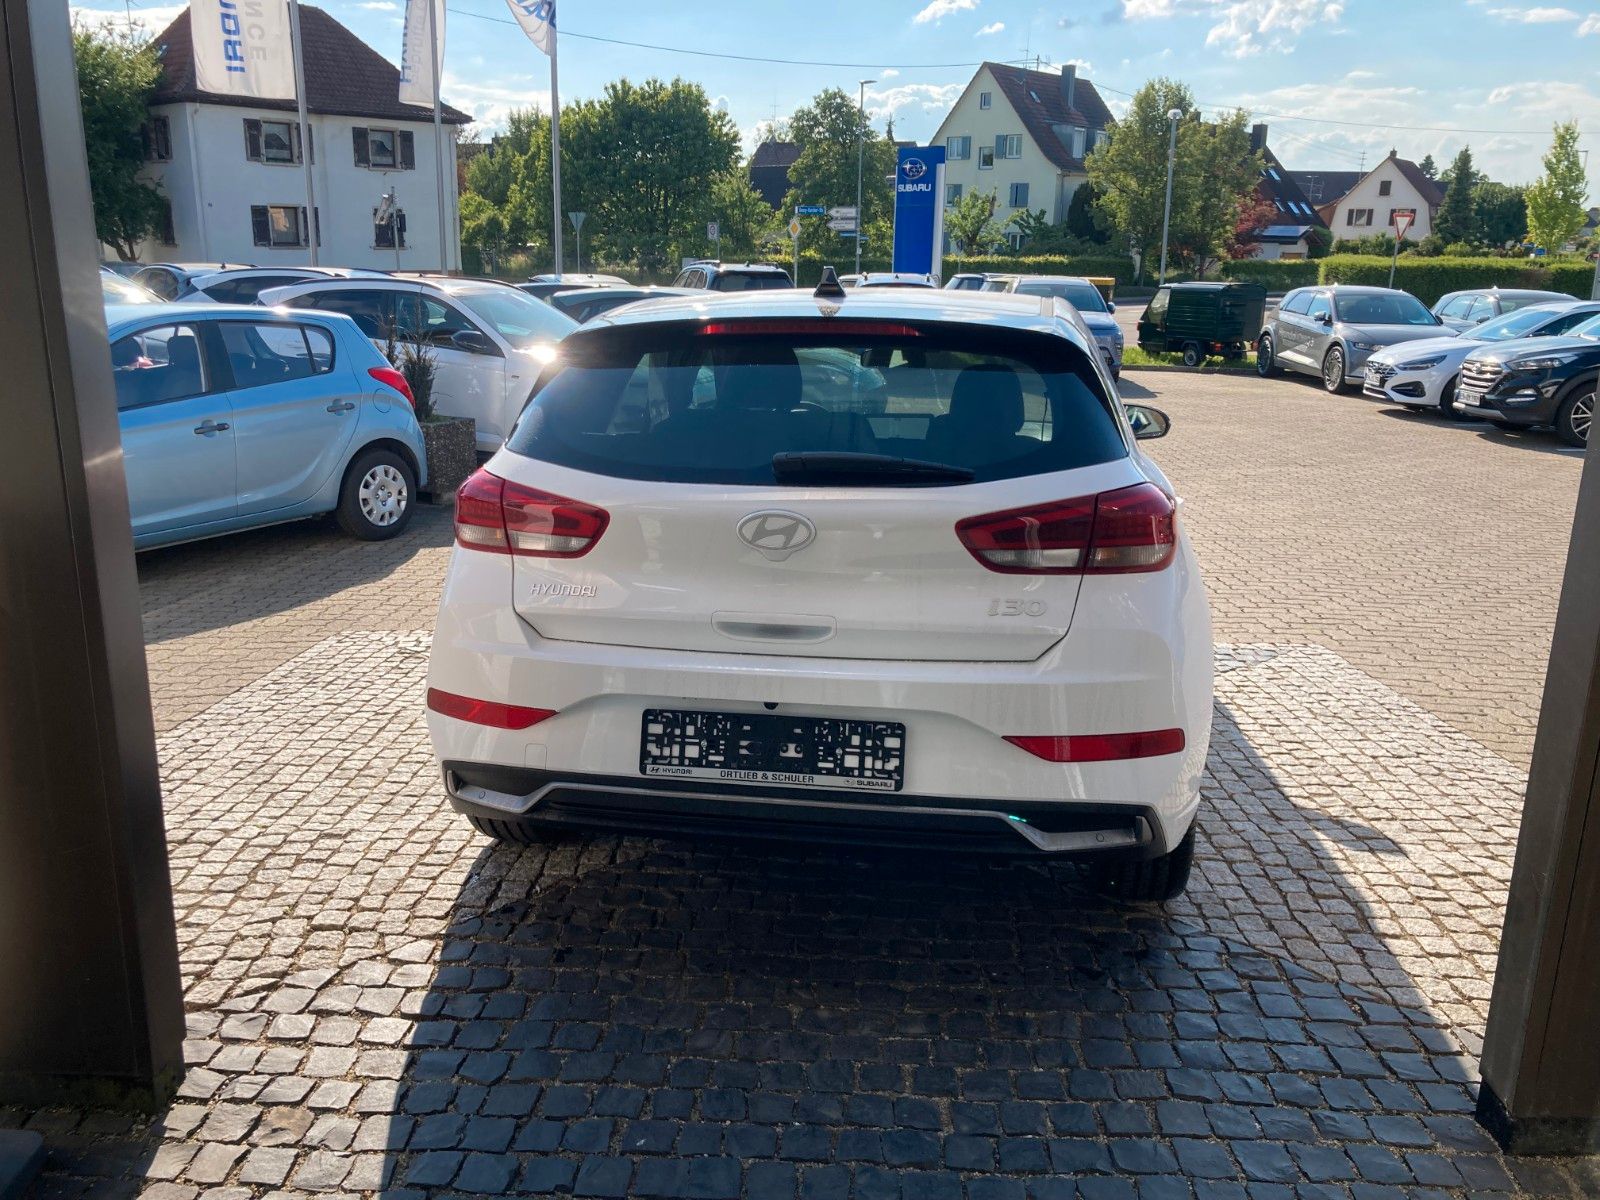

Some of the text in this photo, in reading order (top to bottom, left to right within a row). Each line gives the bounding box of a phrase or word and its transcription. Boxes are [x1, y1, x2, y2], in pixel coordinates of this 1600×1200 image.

[897, 183, 932, 192] SUBARU
[529, 583, 598, 598] HYUNDAI
[662, 767, 693, 775] HYUNDAI
[720, 770, 815, 783] ORTLIEB & SCHULER
[856, 779, 893, 788] SUBARU
